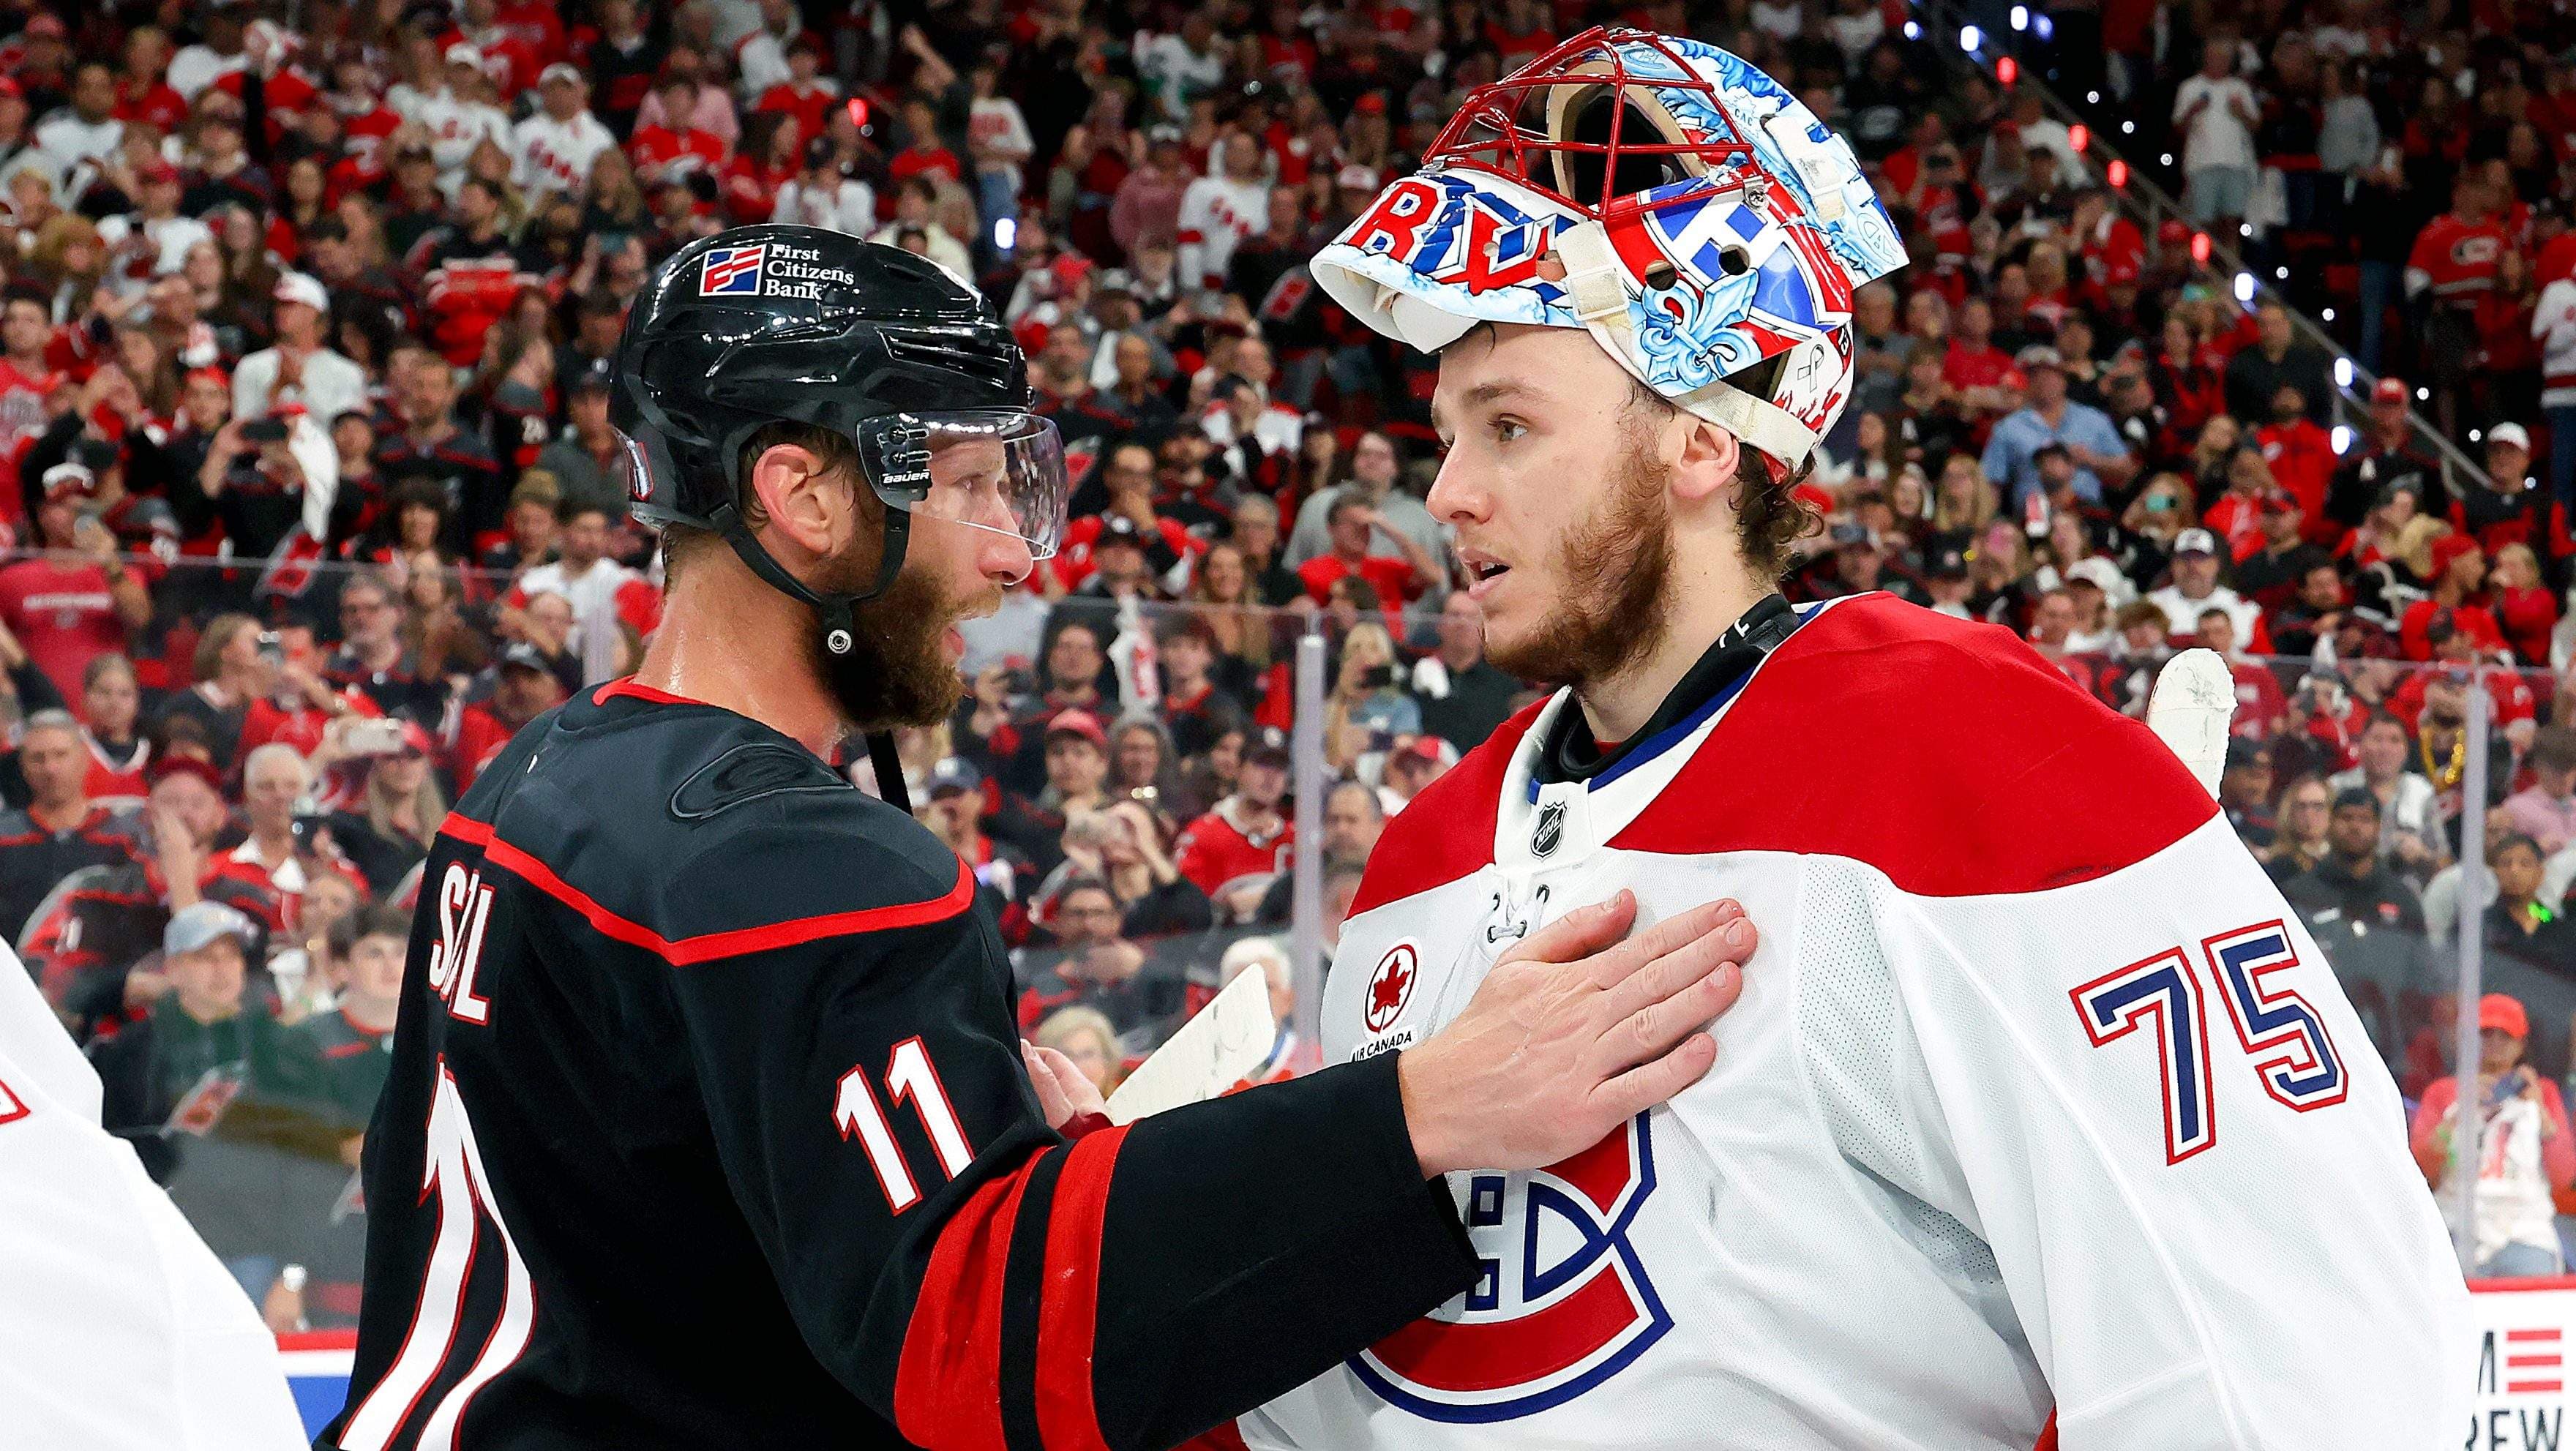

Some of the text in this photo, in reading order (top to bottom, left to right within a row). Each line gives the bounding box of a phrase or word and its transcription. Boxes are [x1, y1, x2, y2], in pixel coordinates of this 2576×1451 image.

[769, 244, 820, 261] First
[767, 260, 855, 285] Citizens
[764, 279, 823, 301] Bank
[1535, 814, 1561, 847] NHL
[1366, 1030, 1412, 1057] CANADA
[2068, 918, 2348, 1166] 75
[831, 1034, 977, 1218] 11
